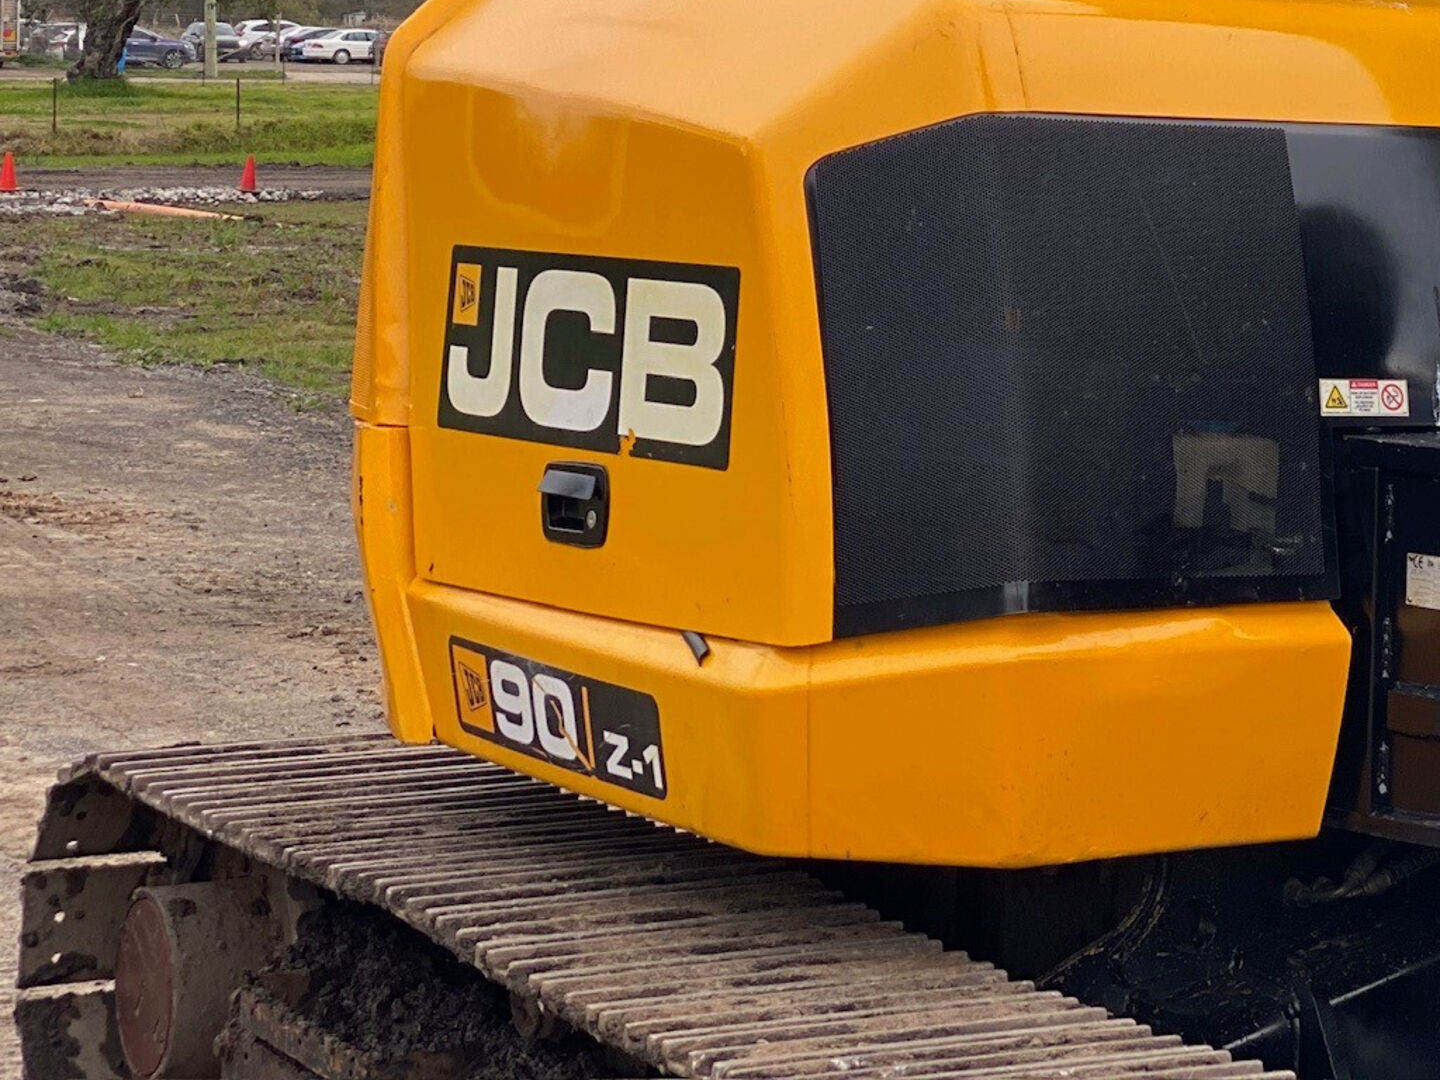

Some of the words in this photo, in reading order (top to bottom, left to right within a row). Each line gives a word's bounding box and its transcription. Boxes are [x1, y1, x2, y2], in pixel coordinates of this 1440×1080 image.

[460, 277, 476, 309] JCB
[447, 266, 727, 446] JCB
[463, 668, 485, 707] JCB
[490, 659, 578, 761] 90
